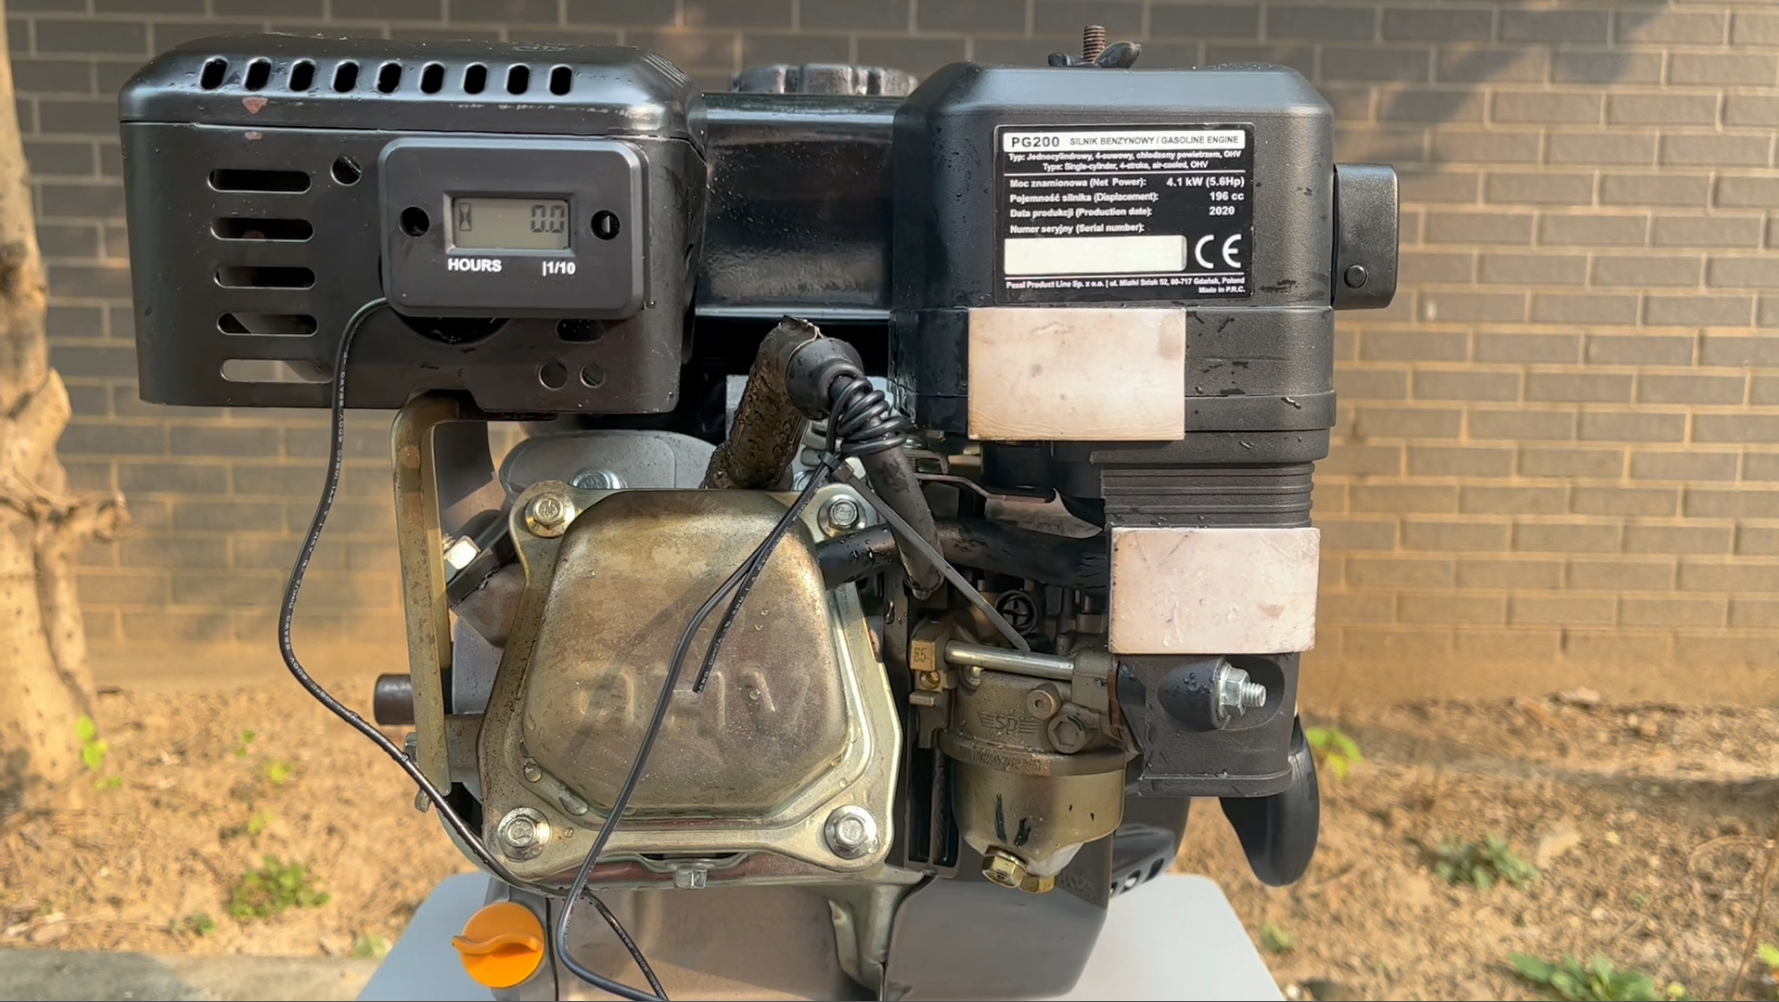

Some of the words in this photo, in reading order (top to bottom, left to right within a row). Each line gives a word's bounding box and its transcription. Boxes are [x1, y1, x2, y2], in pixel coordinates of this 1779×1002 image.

[1011, 136, 1060, 148] PG200
[1070, 137, 1098, 146] SILNIK
[1100, 136, 1155, 145] BENZYNOWY
[1161, 135, 1205, 144] GASOLINE
[1207, 135, 1239, 144] ENGINE
[1008, 153, 1026, 162] Typ:
[1223, 150, 1242, 158] OHV
[1042, 162, 1064, 172] Type:
[1190, 160, 1209, 169] OHV
[1010, 179, 1030, 188] Moc
[1031, 179, 1088, 188] znamionowa
[1089, 178, 1109, 189] (Net
[1112, 177, 1147, 188] Power):
[1166, 177, 1183, 187] 4.1
[1185, 177, 1204, 187] kW
[1205, 176, 1246, 188] (5.6Hp)
[1062, 192, 1092, 202] silnika
[1093, 192, 1159, 204] (Displacement):
[1209, 191, 1229, 201] 196
[1231, 193, 1245, 201] cc
[531, 204, 565, 233] 0.0
[1010, 209, 1031, 218] Data
[1032, 208, 1074, 219] produkcji
[1075, 207, 1127, 218] (Production
[1128, 206, 1153, 217] date):
[1208, 205, 1236, 216] 2020
[1010, 225, 1040, 234] Numer
[1041, 224, 1074, 235] seryjny
[1075, 223, 1104, 234] (Serial
[1105, 222, 1145, 234] number):
[1195, 233, 1242, 269] CE
[447, 258, 502, 273] HOURS
[1027, 280, 1055, 289] Product
[1055, 280, 1072, 288] Line
[1221, 276, 1246, 285] Poland
[1198, 286, 1217, 294] Made
